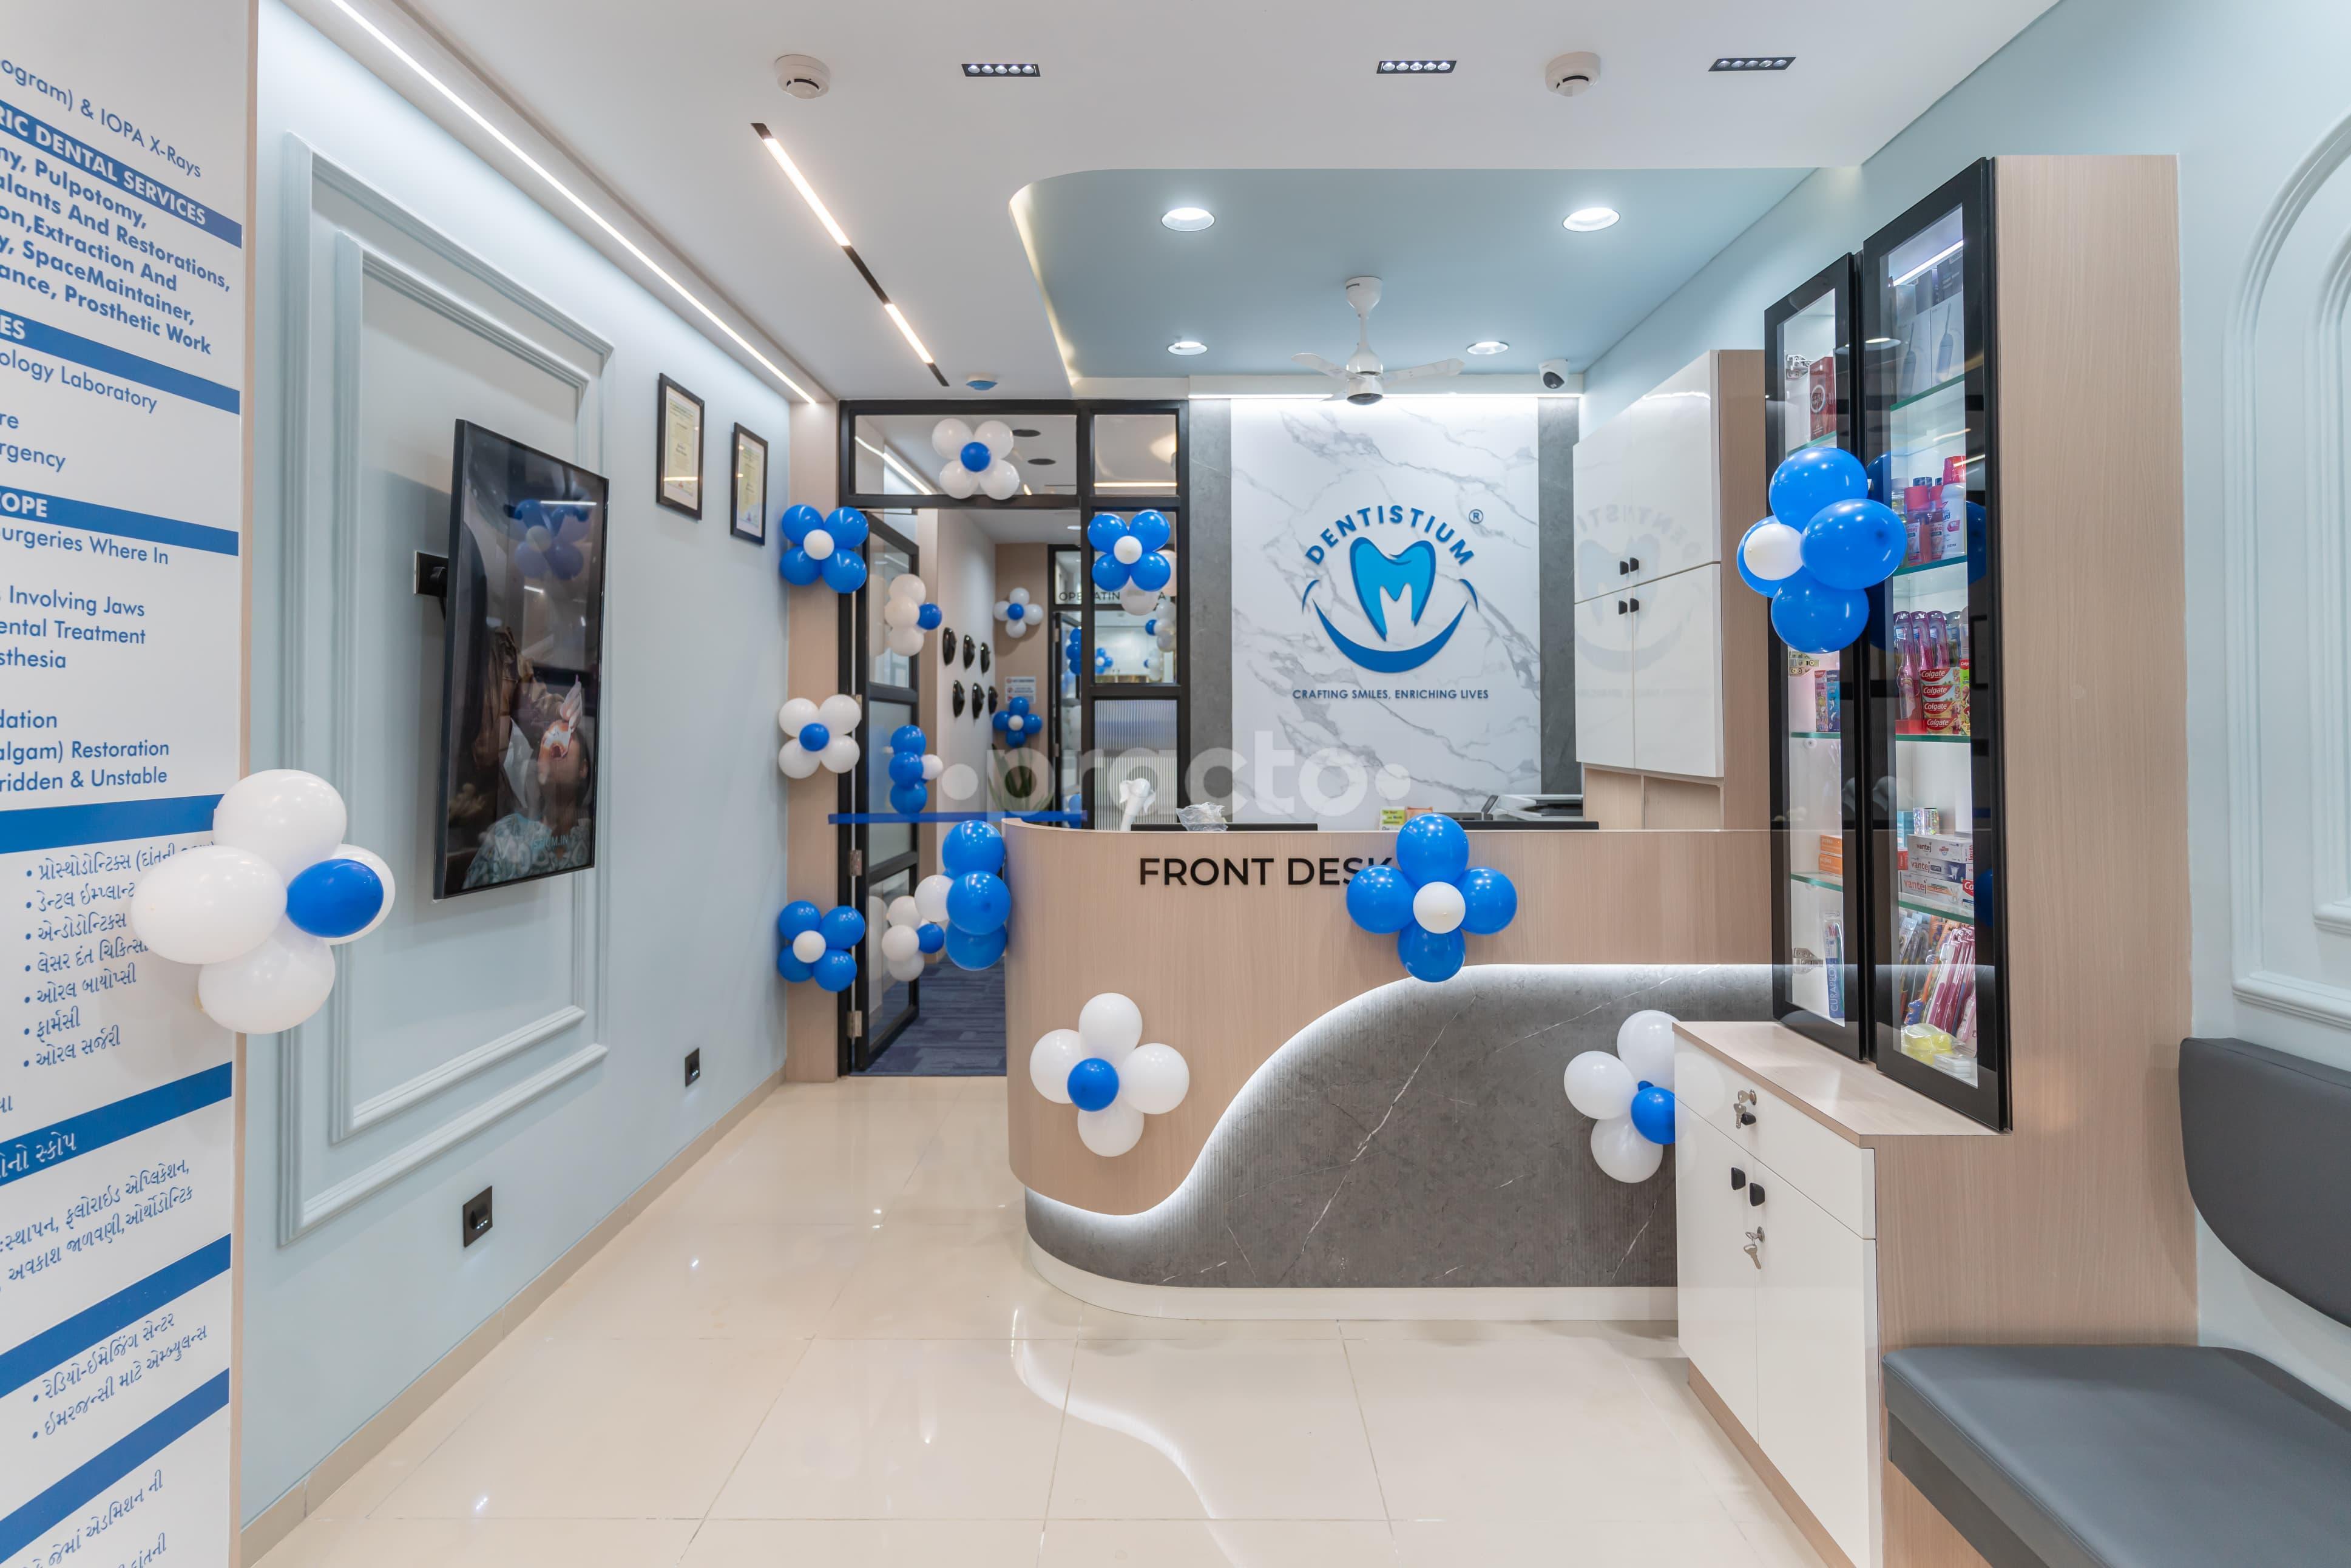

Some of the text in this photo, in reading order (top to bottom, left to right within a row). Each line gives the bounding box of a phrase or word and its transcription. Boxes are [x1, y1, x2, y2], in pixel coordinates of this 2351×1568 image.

[1, 59, 201, 178] ogram) & IOPA X-Rays
[35, 124, 118, 181] DENTAL
[123, 171, 206, 225] SERVICES
[35, 158, 147, 229] Pulpotomy,
[68, 204, 109, 237] And
[117, 224, 230, 292] Restorations,
[140, 263, 177, 291] And
[65, 285, 160, 336] Prosthetic
[166, 323, 211, 355] Work
[61, 365, 157, 414] Laboratory
[2, 527, 168, 564] urgeries Where In
[1305, 505, 1475, 566] DENTISTIUM
[10, 585, 145, 617] Involving Jaws
[54, 620, 146, 644] Treatment
[1921, 670, 1946, 678] Colgate
[1293, 689, 1489, 700] CRAFTING SMILES, ENRICHING LIVES
[1923, 686, 1947, 695] Colgate
[1927, 718, 1949, 727] Colgate
[72, 739, 169, 758] Restoration
[70, 770, 84, 788] &
[92, 766, 167, 786] Unstable
[1916, 842, 1932, 853] vantej
[1140, 857, 1274, 886] FRONT
[1911, 861, 1930, 873] vantej
[1903, 879, 1927, 894] vantej
[38, 952, 70, 973] લેસર
[37, 981, 77, 1003] ઓરલ
[36, 1044, 76, 1066] ઓરલ
[35, 1132, 76, 1163] સ્કોપ
[8, 1247, 61, 1280] અવકાશ
[143, 1313, 175, 1340] સેન્ટર
[119, 1360, 142, 1387] માટે
[148, 1469, 163, 1492] ની
